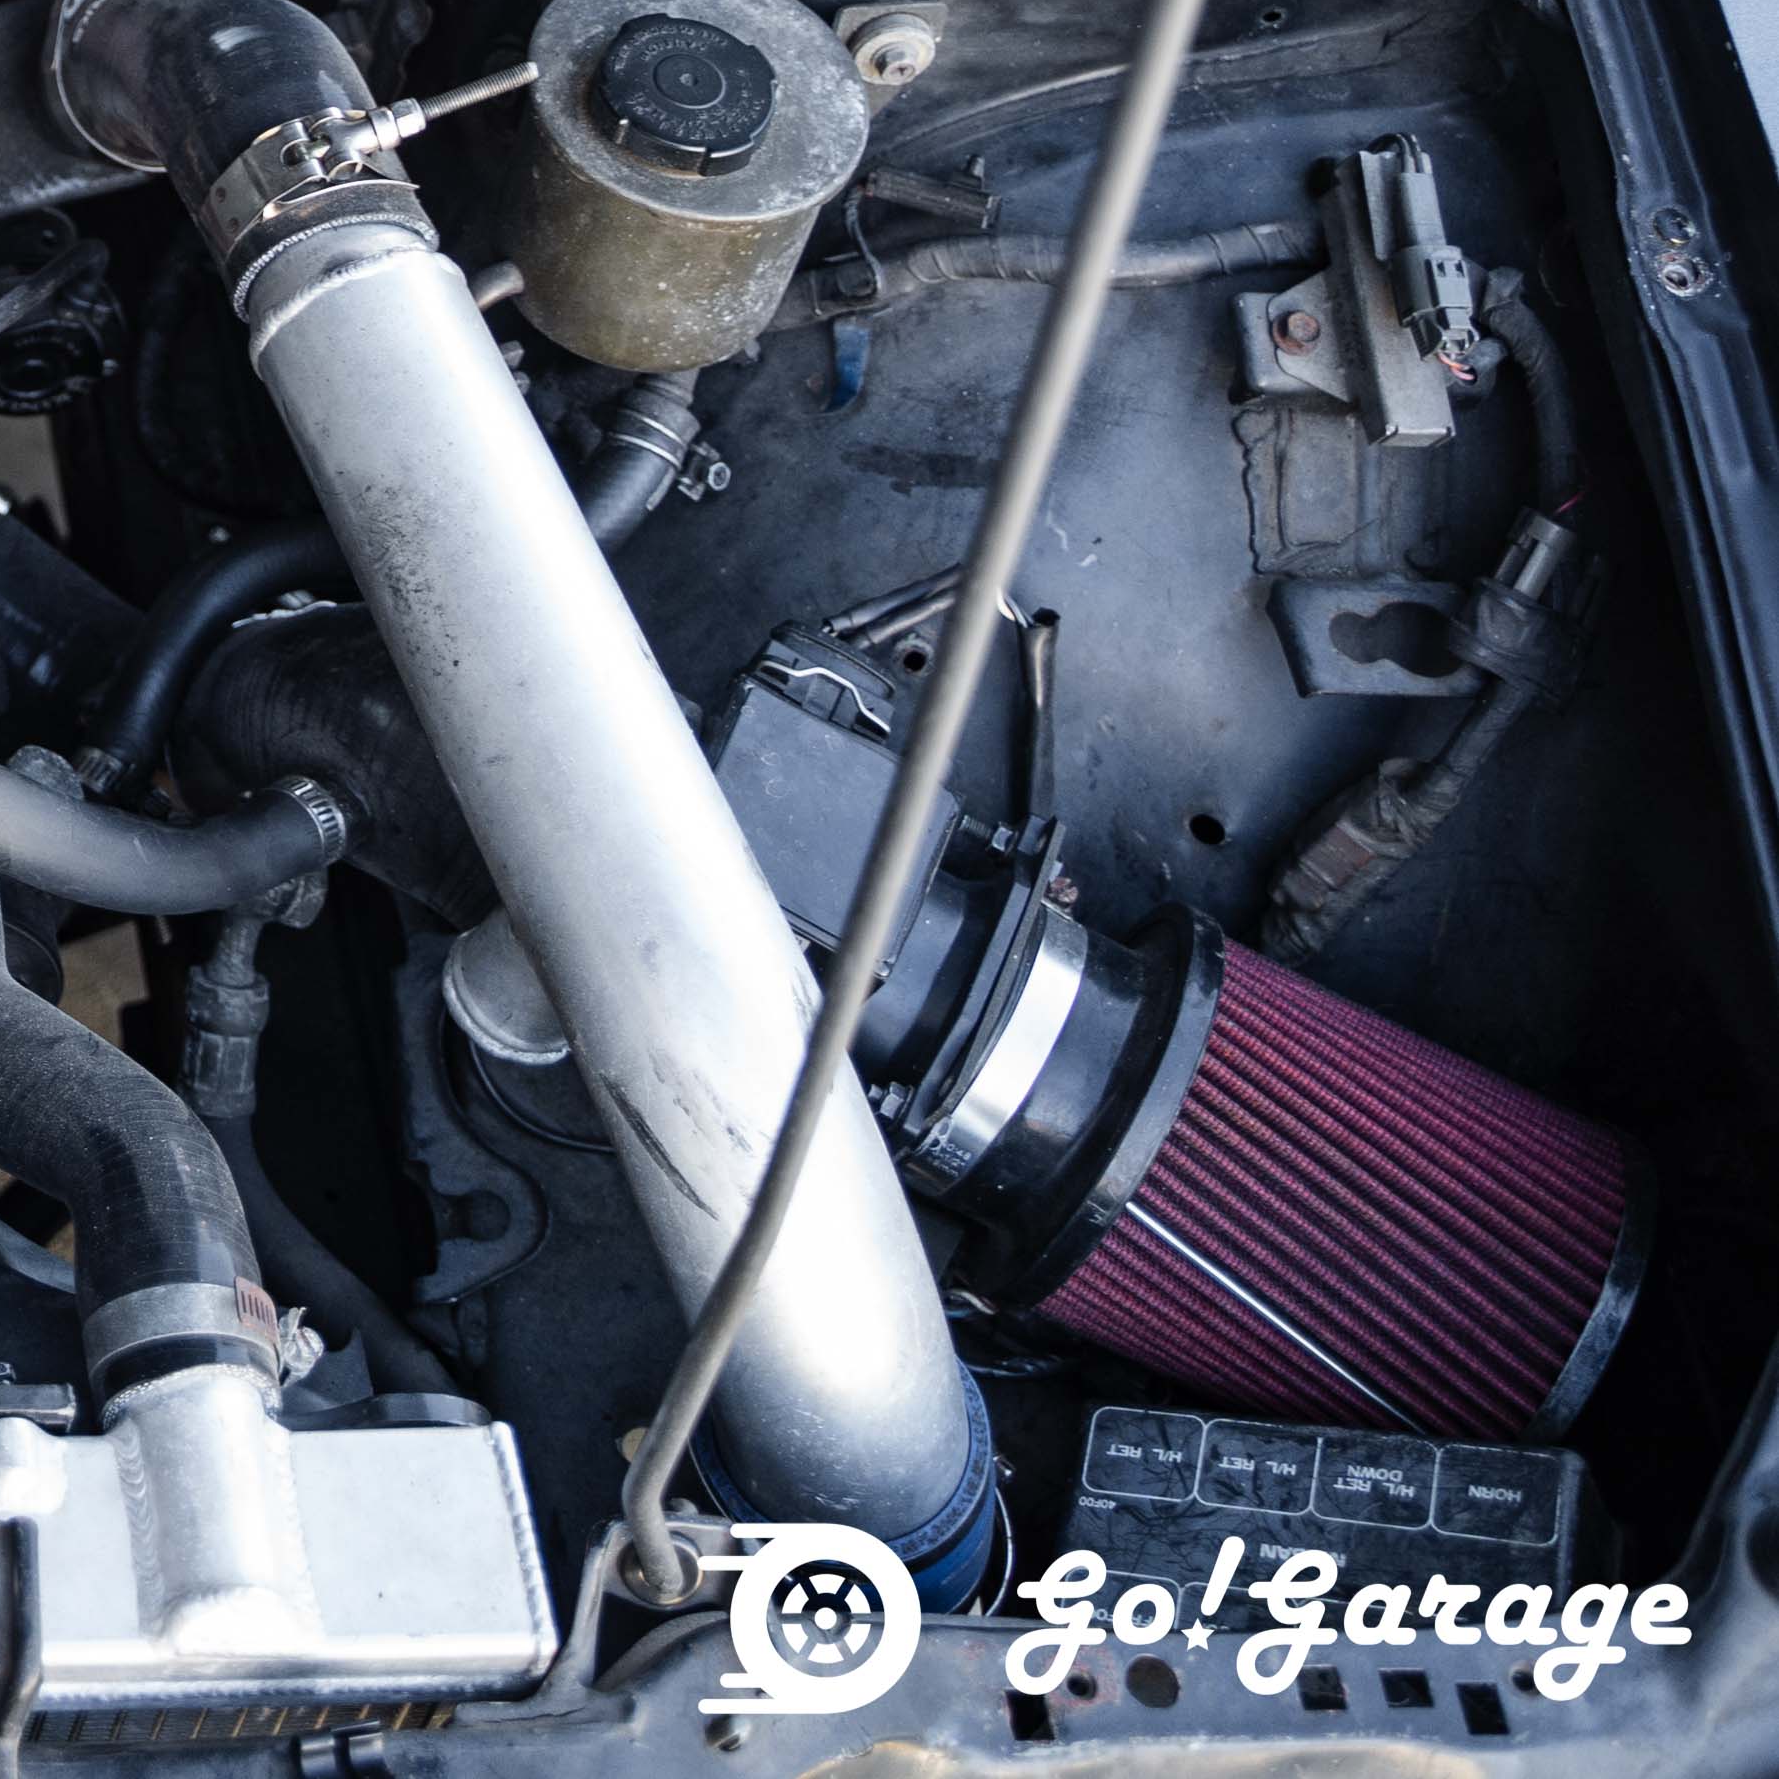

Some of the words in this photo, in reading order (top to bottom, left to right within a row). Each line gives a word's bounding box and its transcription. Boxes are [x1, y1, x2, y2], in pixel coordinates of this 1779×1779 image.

[1104, 1442, 1142, 1458] RET
[1149, 1447, 1182, 1464] H/L
[1217, 1454, 1255, 1470] RET
[1263, 1459, 1297, 1474] H/L
[1345, 1463, 1403, 1481] DOWN
[1332, 1474, 1372, 1493] RET
[1380, 1480, 1414, 1497] H/L
[1077, 1495, 1117, 1510] 40F00
[1467, 1484, 1521, 1504] HORN
